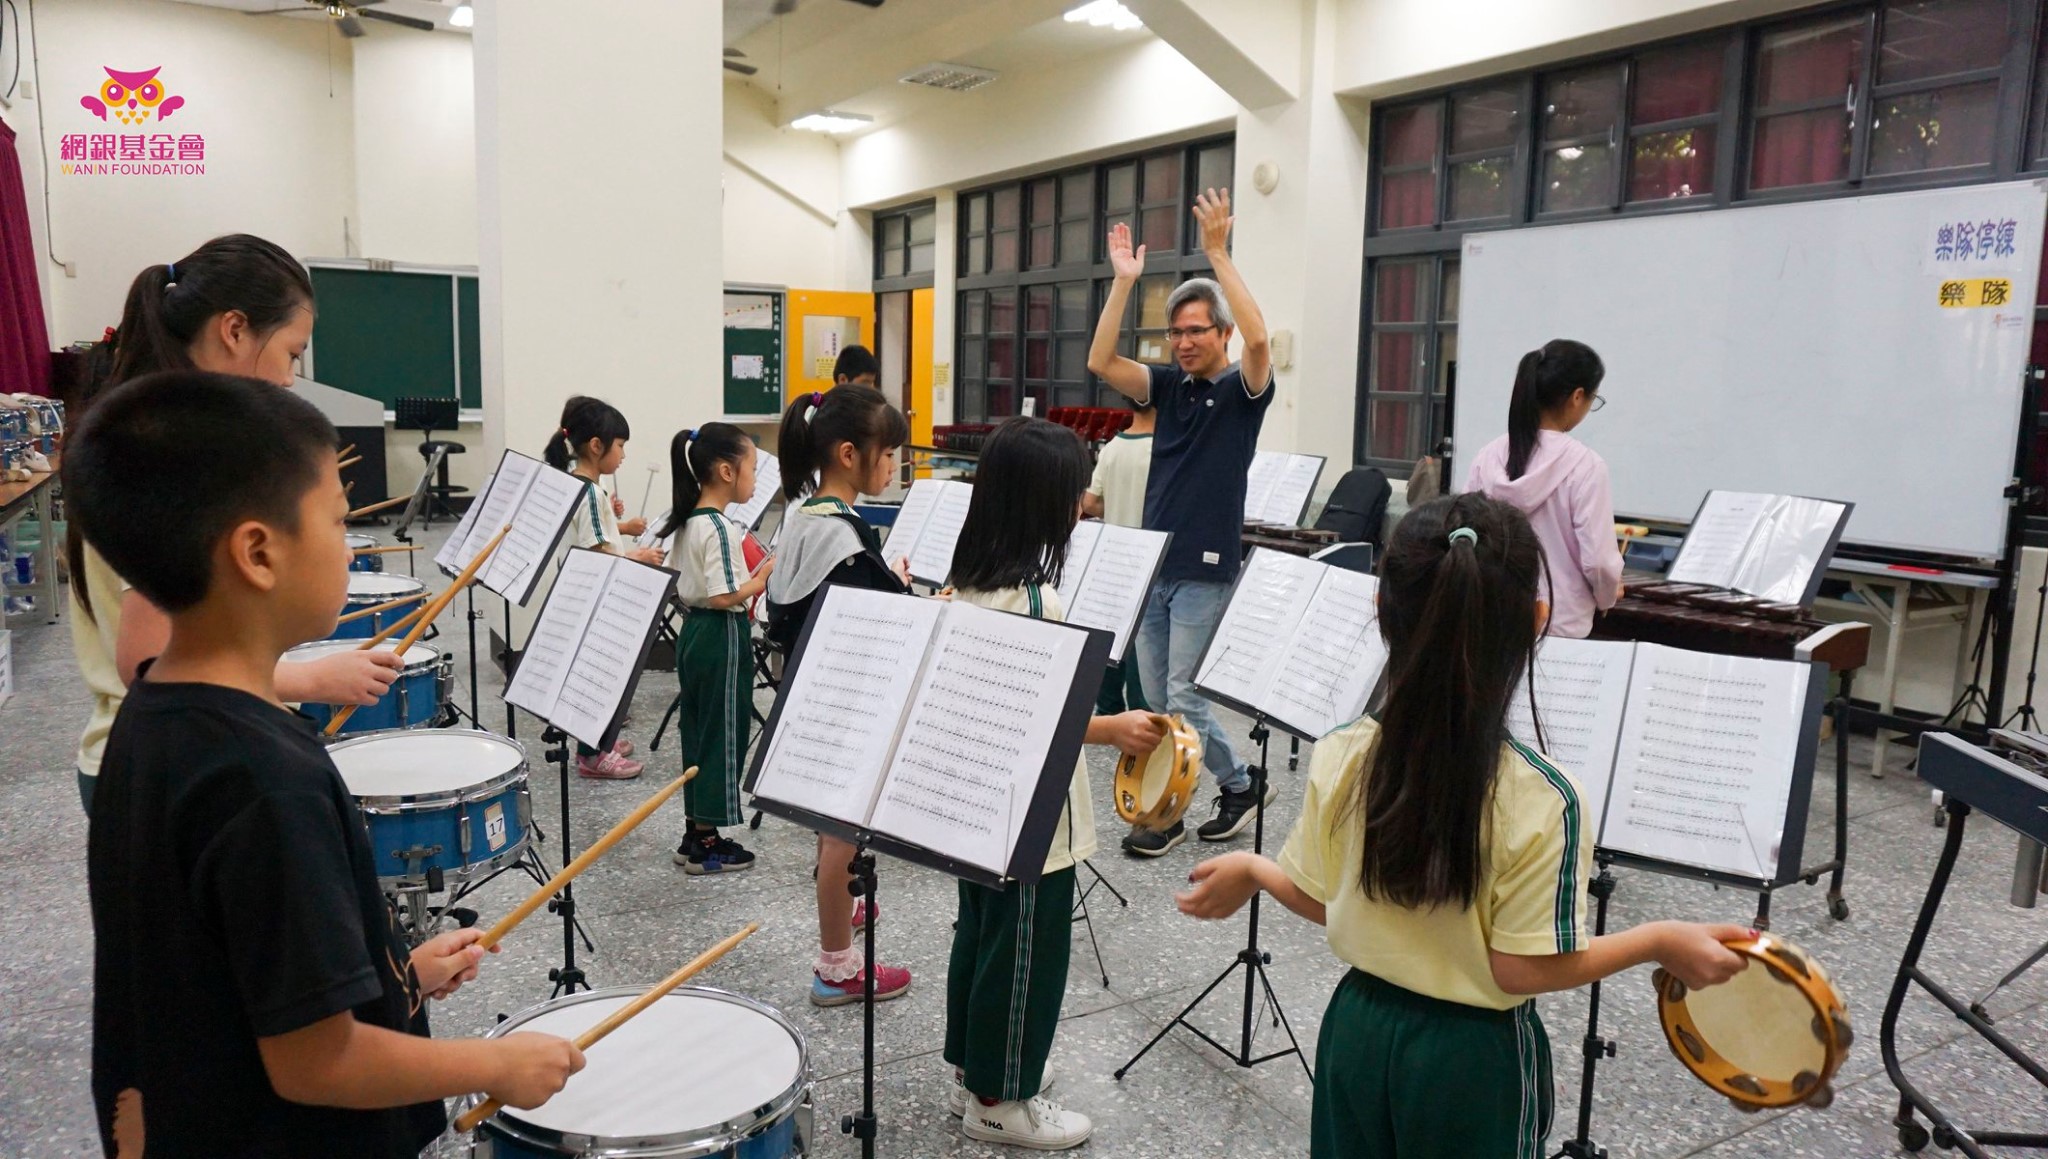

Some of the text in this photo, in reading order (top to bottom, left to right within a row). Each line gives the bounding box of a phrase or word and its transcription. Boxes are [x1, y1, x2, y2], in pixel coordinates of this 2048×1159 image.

[1935, 218, 2018, 261] 樂隊停練
[489, 817, 503, 837] 17
